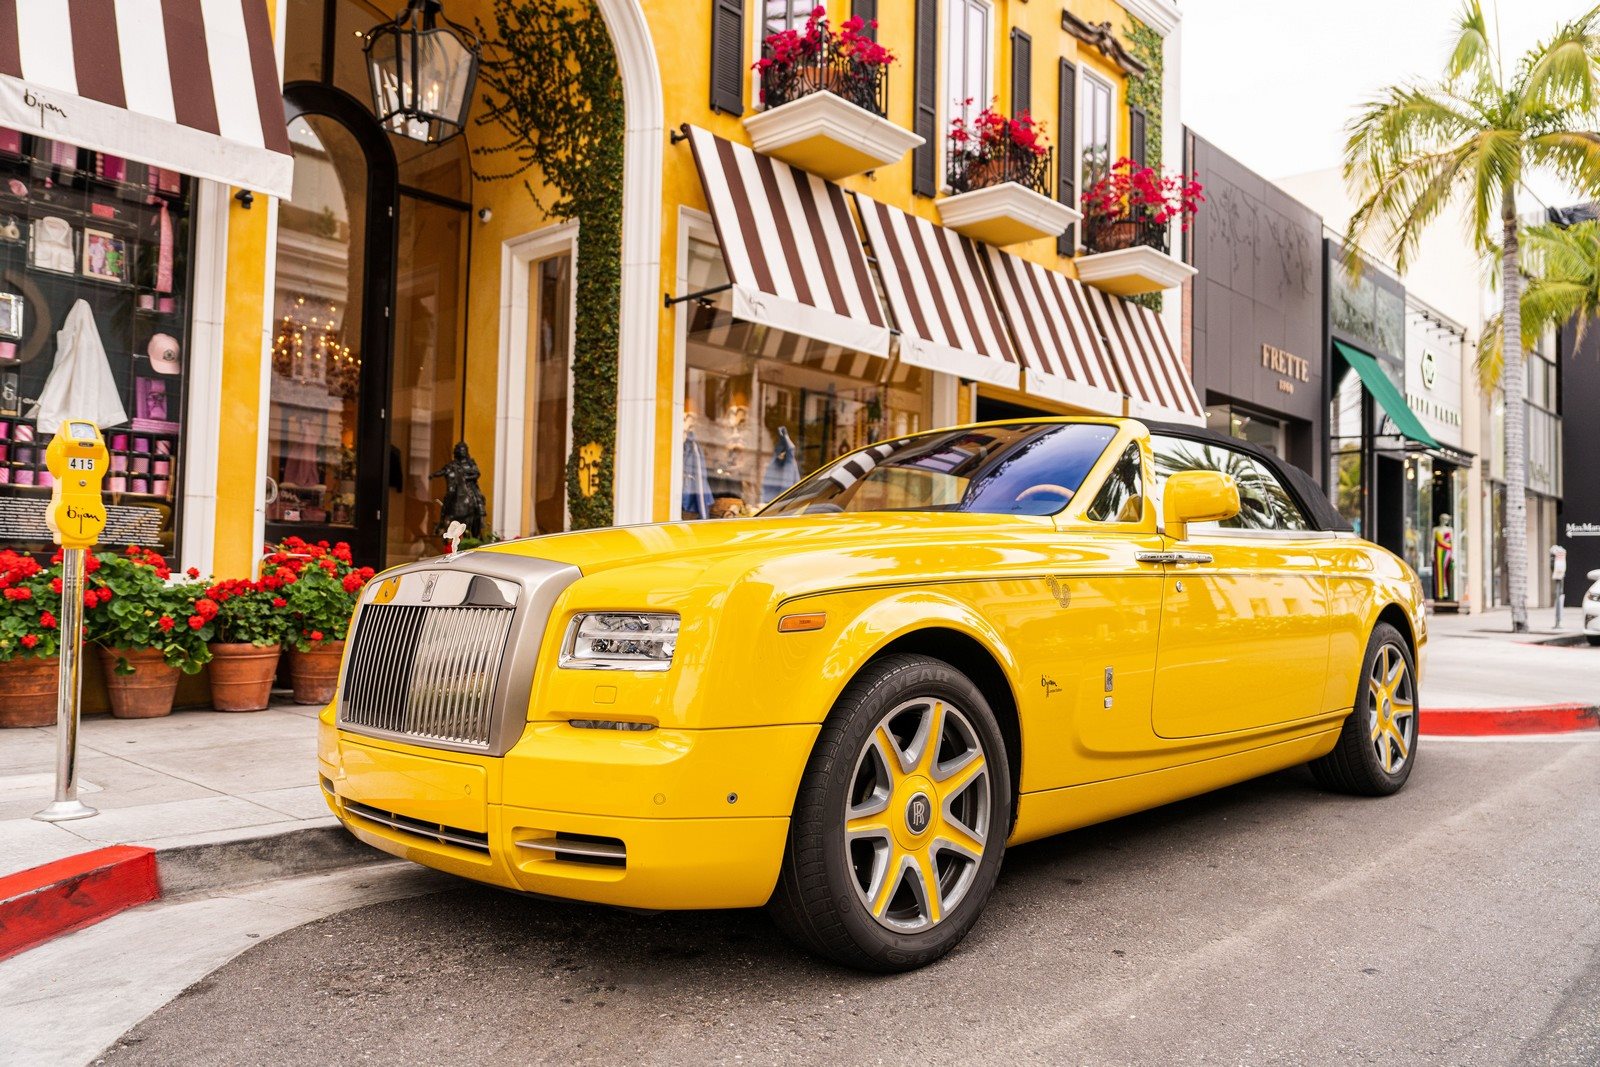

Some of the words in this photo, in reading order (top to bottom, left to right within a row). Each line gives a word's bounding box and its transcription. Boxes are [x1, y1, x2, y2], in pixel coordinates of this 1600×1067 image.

[23, 88, 67, 129] bijan
[1261, 343, 1309, 383] FRETTE
[70, 459, 94, 470] 415
[67, 505, 101, 534] bijan
